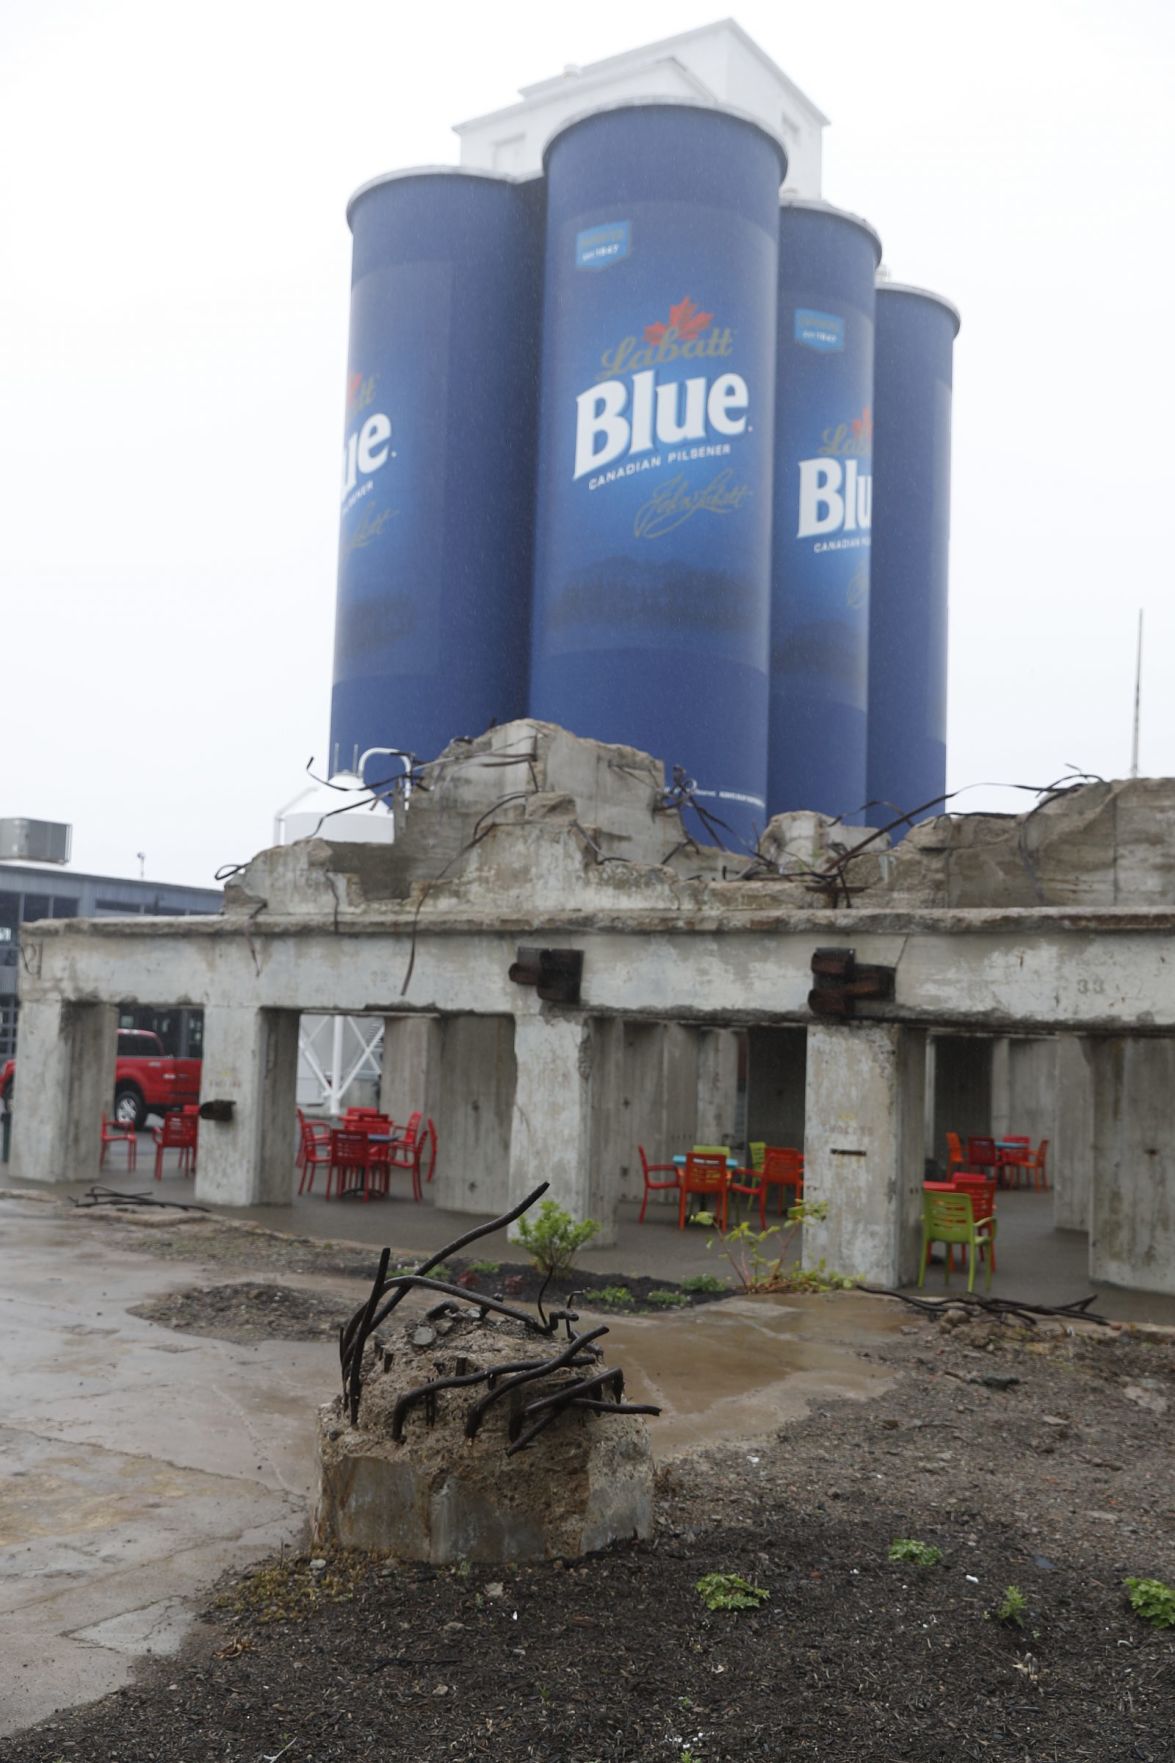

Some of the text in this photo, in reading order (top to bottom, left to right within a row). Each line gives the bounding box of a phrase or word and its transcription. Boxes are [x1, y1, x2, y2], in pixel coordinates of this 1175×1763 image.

[573, 369, 749, 481] Blue
[588, 443, 732, 490] CANADIAN PILSENER
